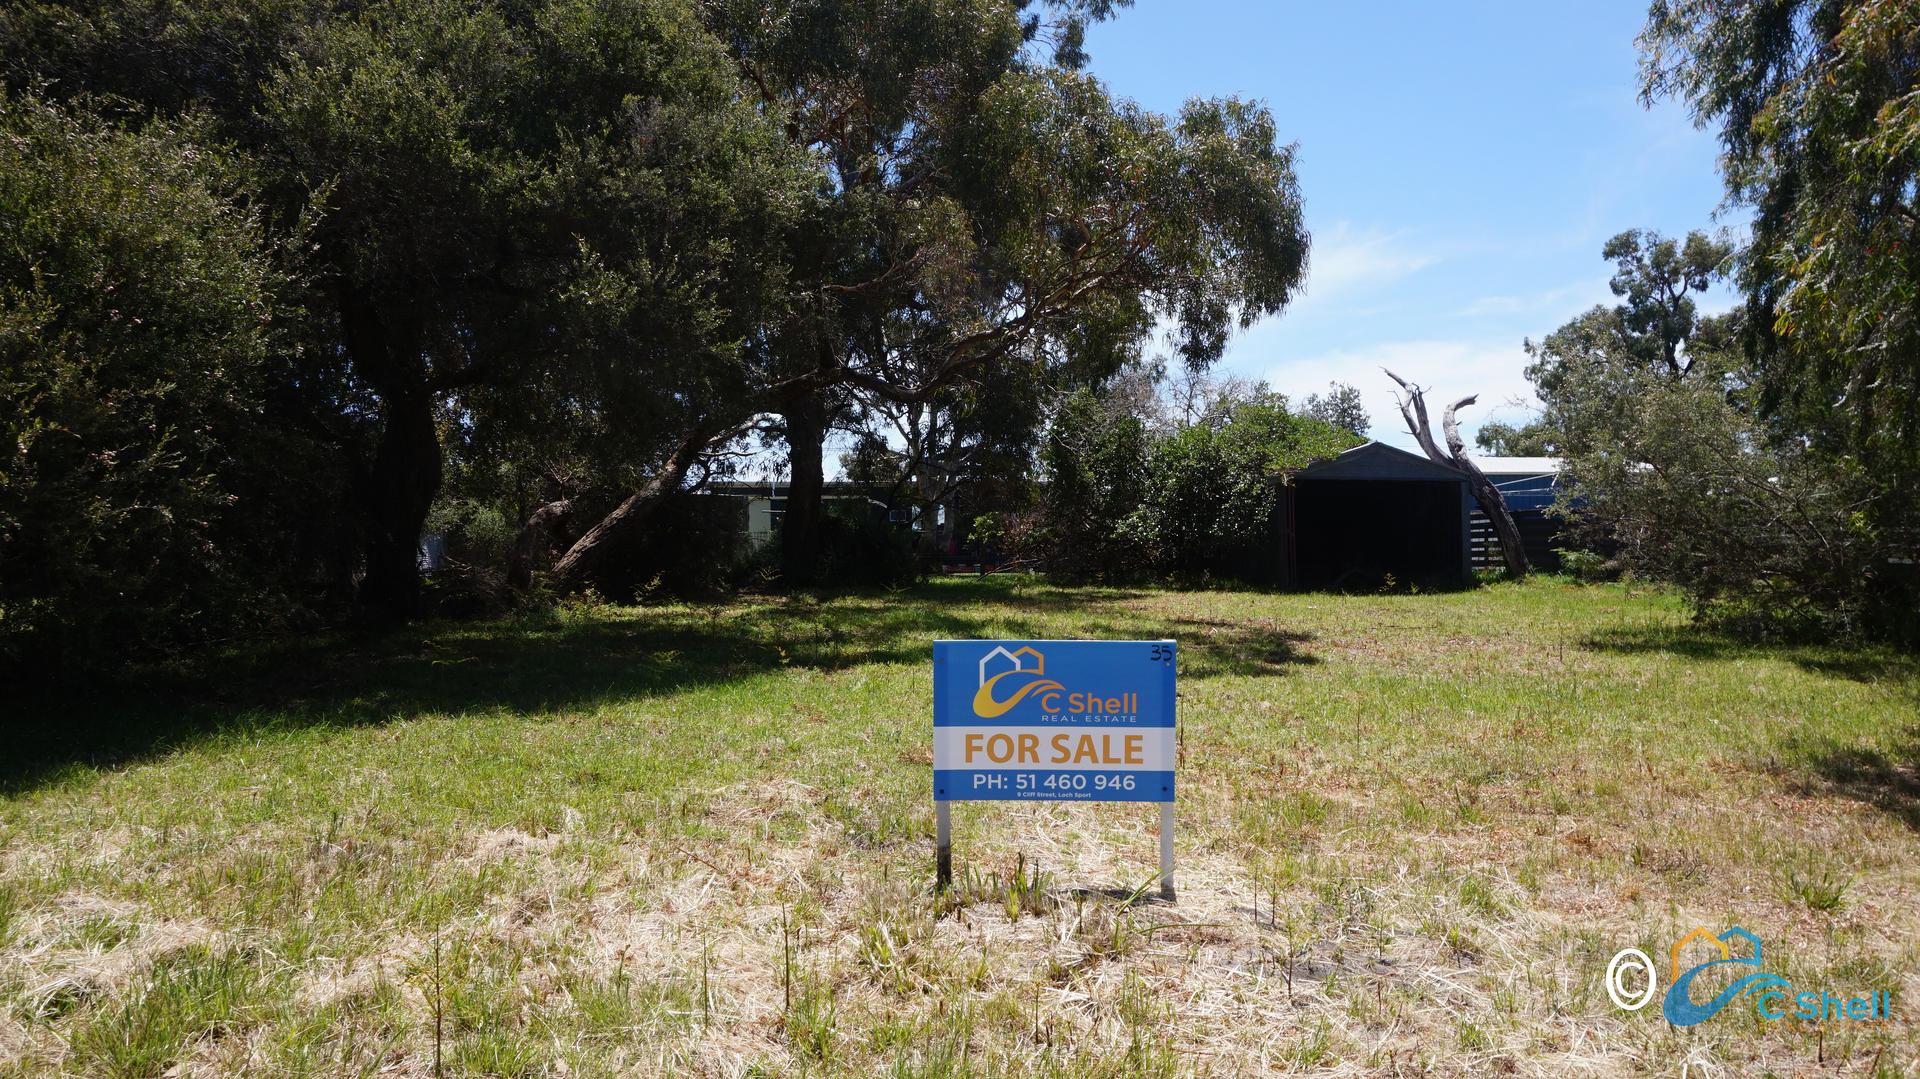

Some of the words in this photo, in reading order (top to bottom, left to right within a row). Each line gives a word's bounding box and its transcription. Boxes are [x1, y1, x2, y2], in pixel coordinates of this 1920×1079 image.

[1151, 644, 1173, 662] 35
[1041, 693, 1060, 713] C
[1068, 693, 1137, 713] Shell
[1085, 715, 1137, 723] ESTATE
[965, 734, 1040, 763] FOR
[1050, 734, 1144, 764] SALE
[973, 774, 1008, 789] PH:
[1016, 774, 1036, 789] 51
[1043, 774, 1087, 790] 460
[1094, 775, 1136, 790] 946
